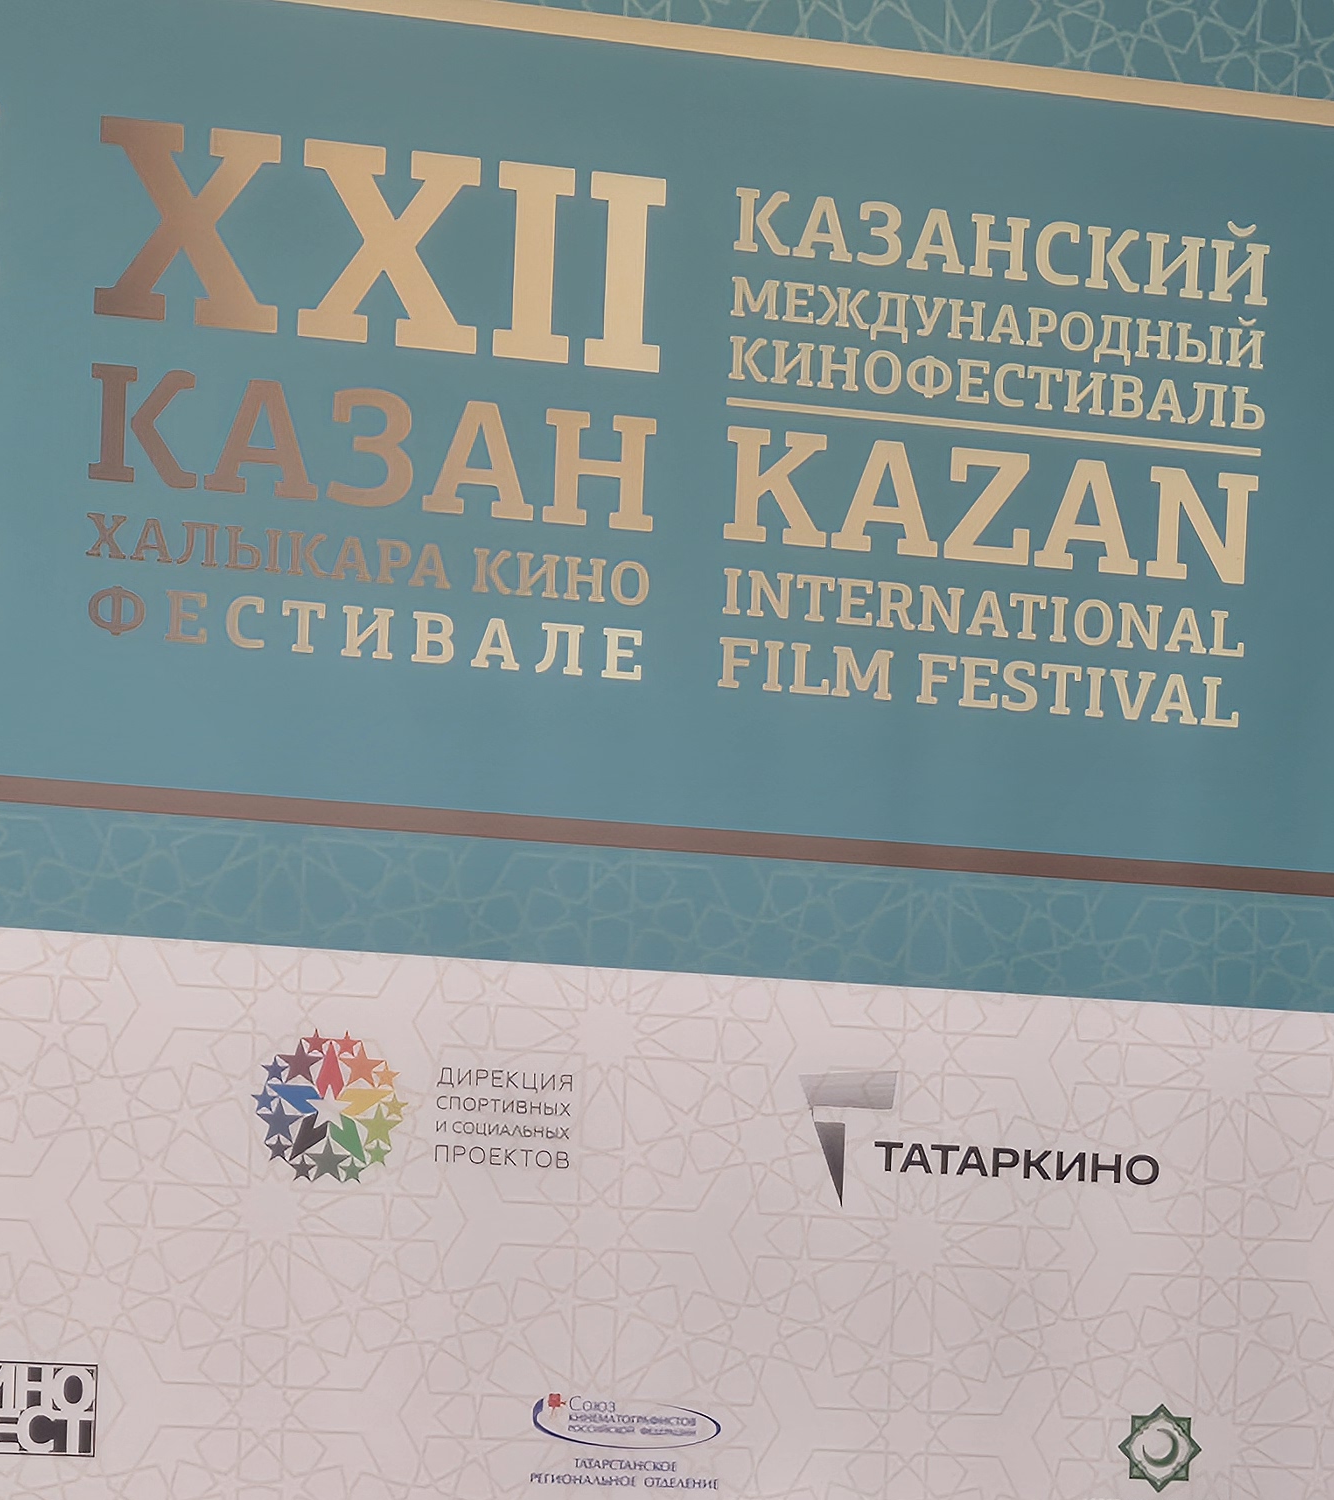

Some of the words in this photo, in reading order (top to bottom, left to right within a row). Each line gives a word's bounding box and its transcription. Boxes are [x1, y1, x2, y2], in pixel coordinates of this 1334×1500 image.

[93, 115, 666, 373] XXII
[733, 187, 1269, 306] КАЗАНСКИЙ
[730, 276, 1265, 370] МЕЖДУНАРОДНЫЙ
[728, 336, 1265, 430] КИНОФЕСТИВАЛЬ
[88, 362, 657, 532] КАЗАН
[723, 425, 1259, 585] KAZAN
[85, 513, 450, 588] ХАЛЫКАРА
[472, 547, 649, 605] КИНО
[88, 585, 642, 680] ФЕСТИВАЛЕ
[722, 567, 1244, 658] INTERNATIONAL
[717, 637, 893, 700] FILM
[916, 653, 1238, 728] FESTIVAL
[436, 1067, 573, 1093] ДИРЕКЦИЯ
[436, 1095, 571, 1117] СПОРТИВНЫХ
[434, 1144, 570, 1169] ПРОЕКТОВ
[436, 1121, 447, 1132] И
[452, 1121, 570, 1139] СОЦИАЛЬНЫХ
[874, 1141, 1160, 1186] ТАТАРКИНО
[530, 1473, 636, 1486] РЕГИОНАЛЬНОЕ
[644, 1476, 718, 1490] ОТДЕЛЕНИЕ
[574, 1458, 677, 1471] ТАТАРСТАНСКОЕ
